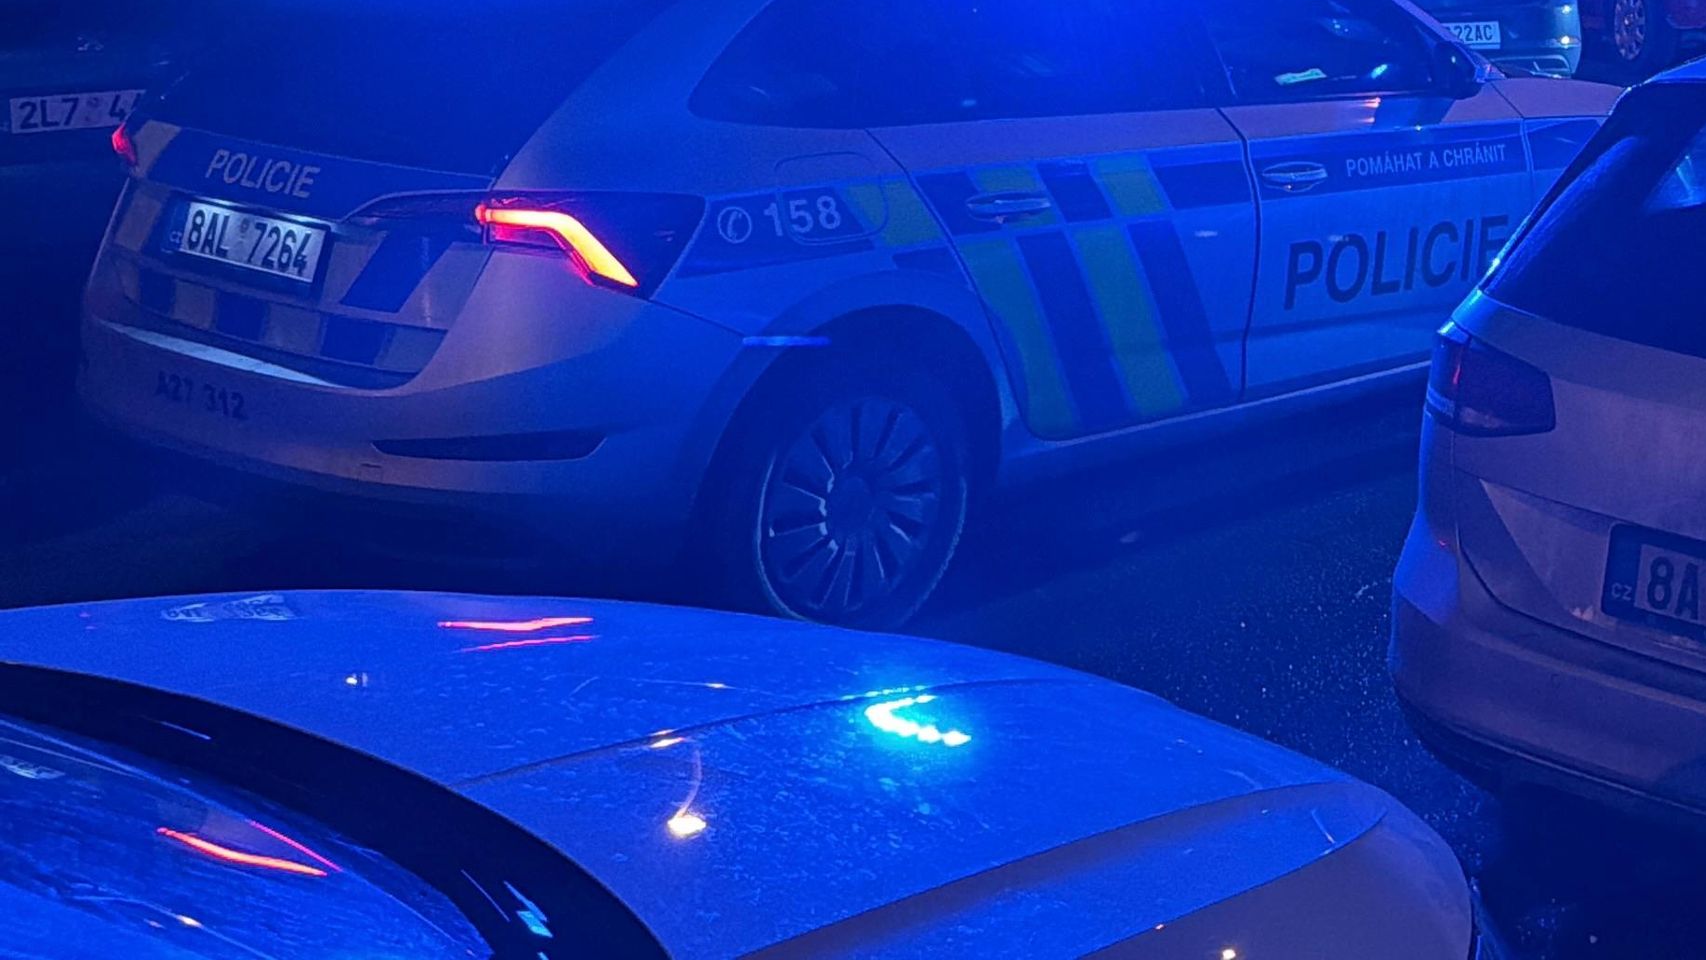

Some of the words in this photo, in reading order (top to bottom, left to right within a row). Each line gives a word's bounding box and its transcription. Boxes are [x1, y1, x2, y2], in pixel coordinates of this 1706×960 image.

[18, 97, 79, 130] 2L7
[204, 148, 322, 199] POLICIE
[1346, 150, 1423, 178] POMÁHAT
[1429, 151, 1440, 169] A
[1443, 141, 1507, 168] CHRÁNIT
[763, 195, 841, 237] 158
[186, 209, 231, 258] 8AL
[246, 221, 313, 275] 7264
[1611, 582, 1633, 601] CZ
